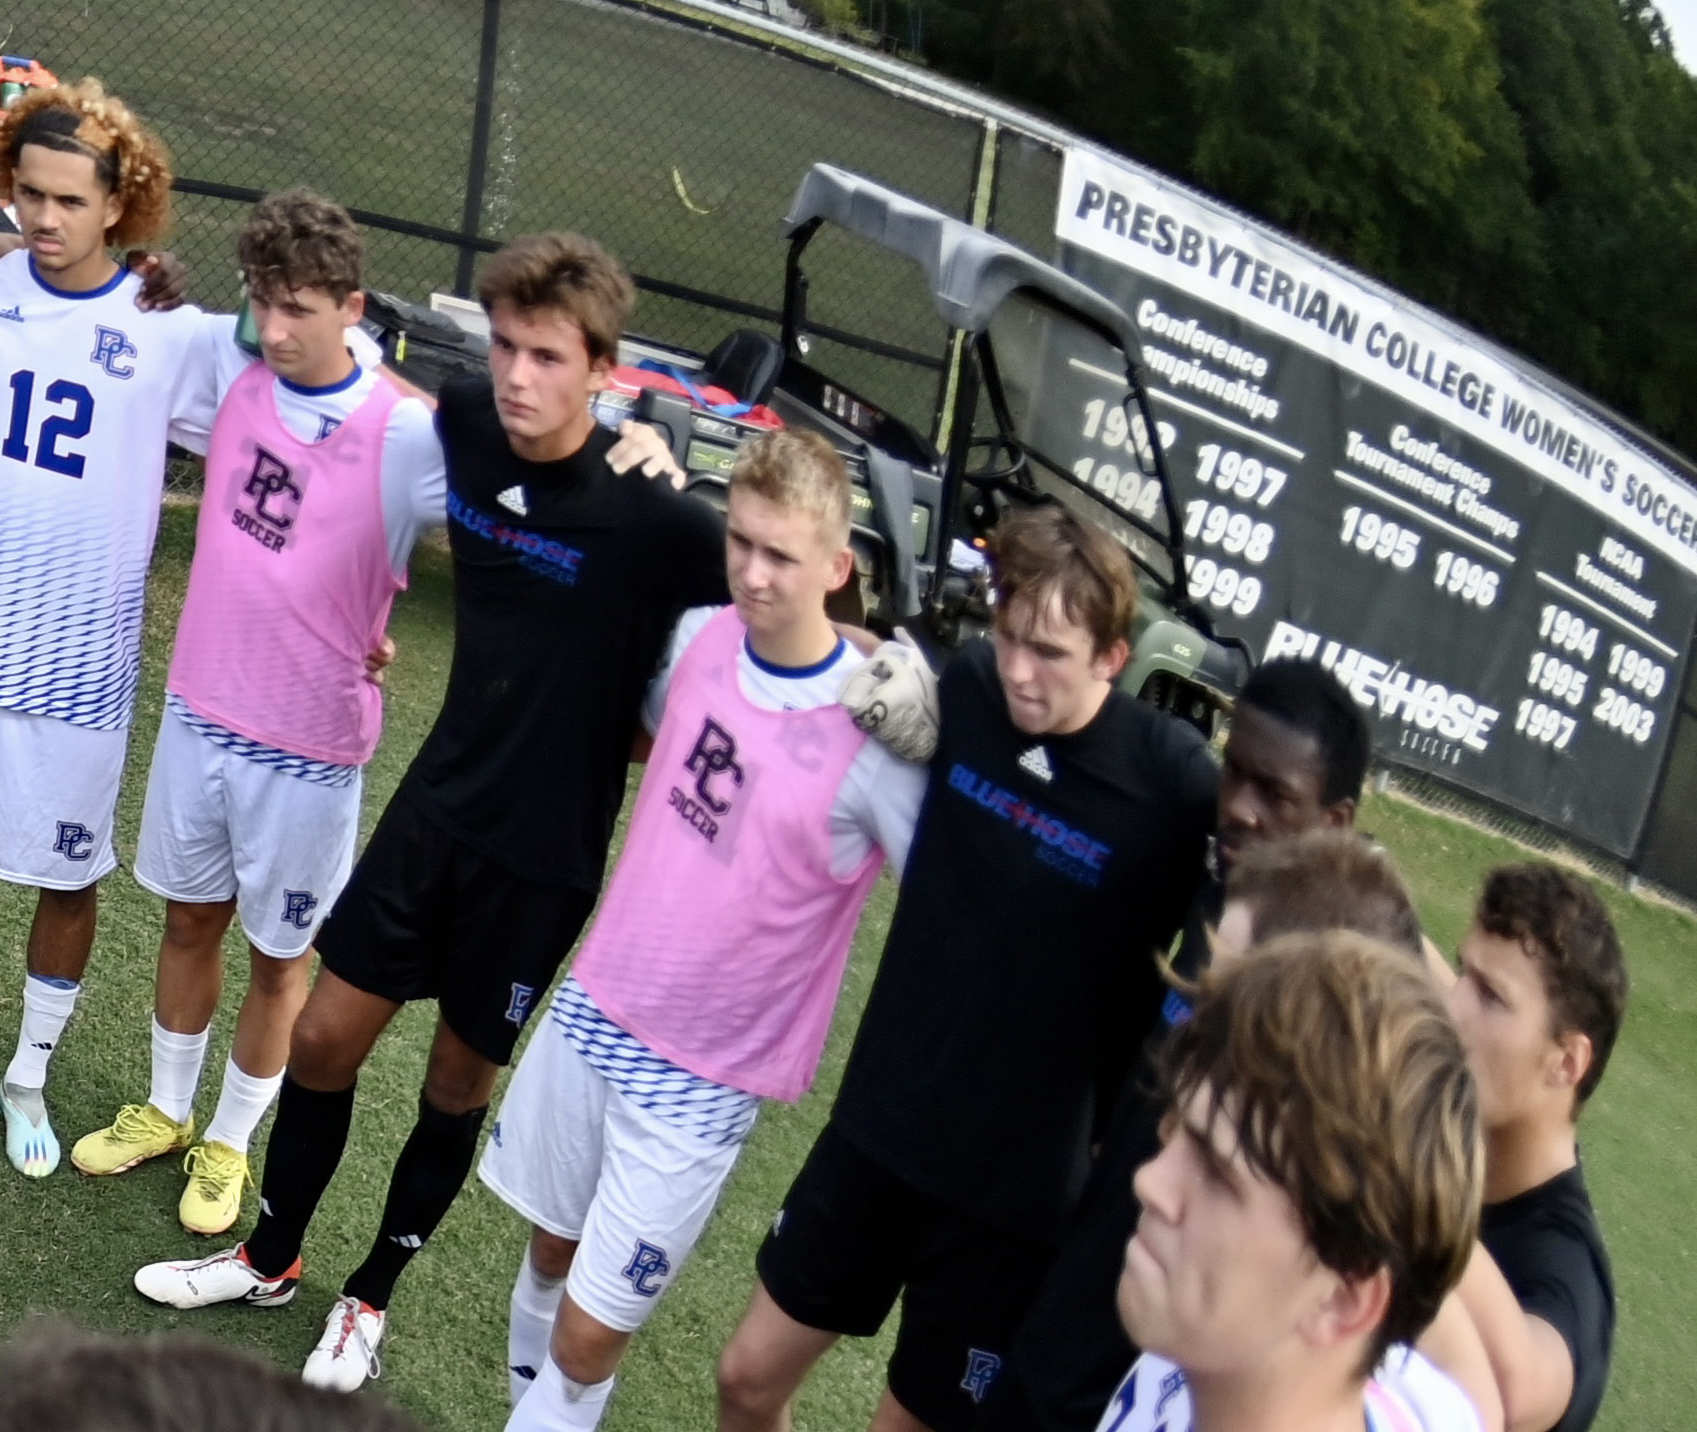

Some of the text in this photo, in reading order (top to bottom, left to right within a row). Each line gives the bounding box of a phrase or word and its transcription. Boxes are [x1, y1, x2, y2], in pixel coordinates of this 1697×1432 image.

[90, 323, 138, 381] PC
[1075, 179, 1361, 346] PRESBYTERIAN
[1365, 321, 1496, 420] COLLEGE
[1500, 393, 1619, 493] WOMEN'S
[1137, 299, 1269, 377] Conference
[1143, 345, 1279, 420] ampionships
[1, 369, 95, 480] 12
[243, 443, 303, 532] PC
[1195, 443, 1287, 507] 1997
[1346, 430, 1520, 540] Tournament Champs
[1390, 424, 1492, 495] Conference
[231, 509, 286, 554] SOCCER
[1183, 499, 1275, 563] 1998
[1340, 505, 1500, 607] 1995 1996
[1599, 536, 1645, 580] NCAA
[1576, 553, 1657, 620] Tournament
[1539, 604, 1667, 698] 1994 1999
[1514, 698, 1578, 749] 1997
[1527, 652, 1656, 742] 1995 2003
[683, 714, 742, 817] PC
[948, 763, 1021, 821] BLUE
[53, 820, 95, 862] PC
[668, 786, 718, 843] SOCCER
[279, 888, 320, 931] PC
[619, 1237, 671, 1299] PC
